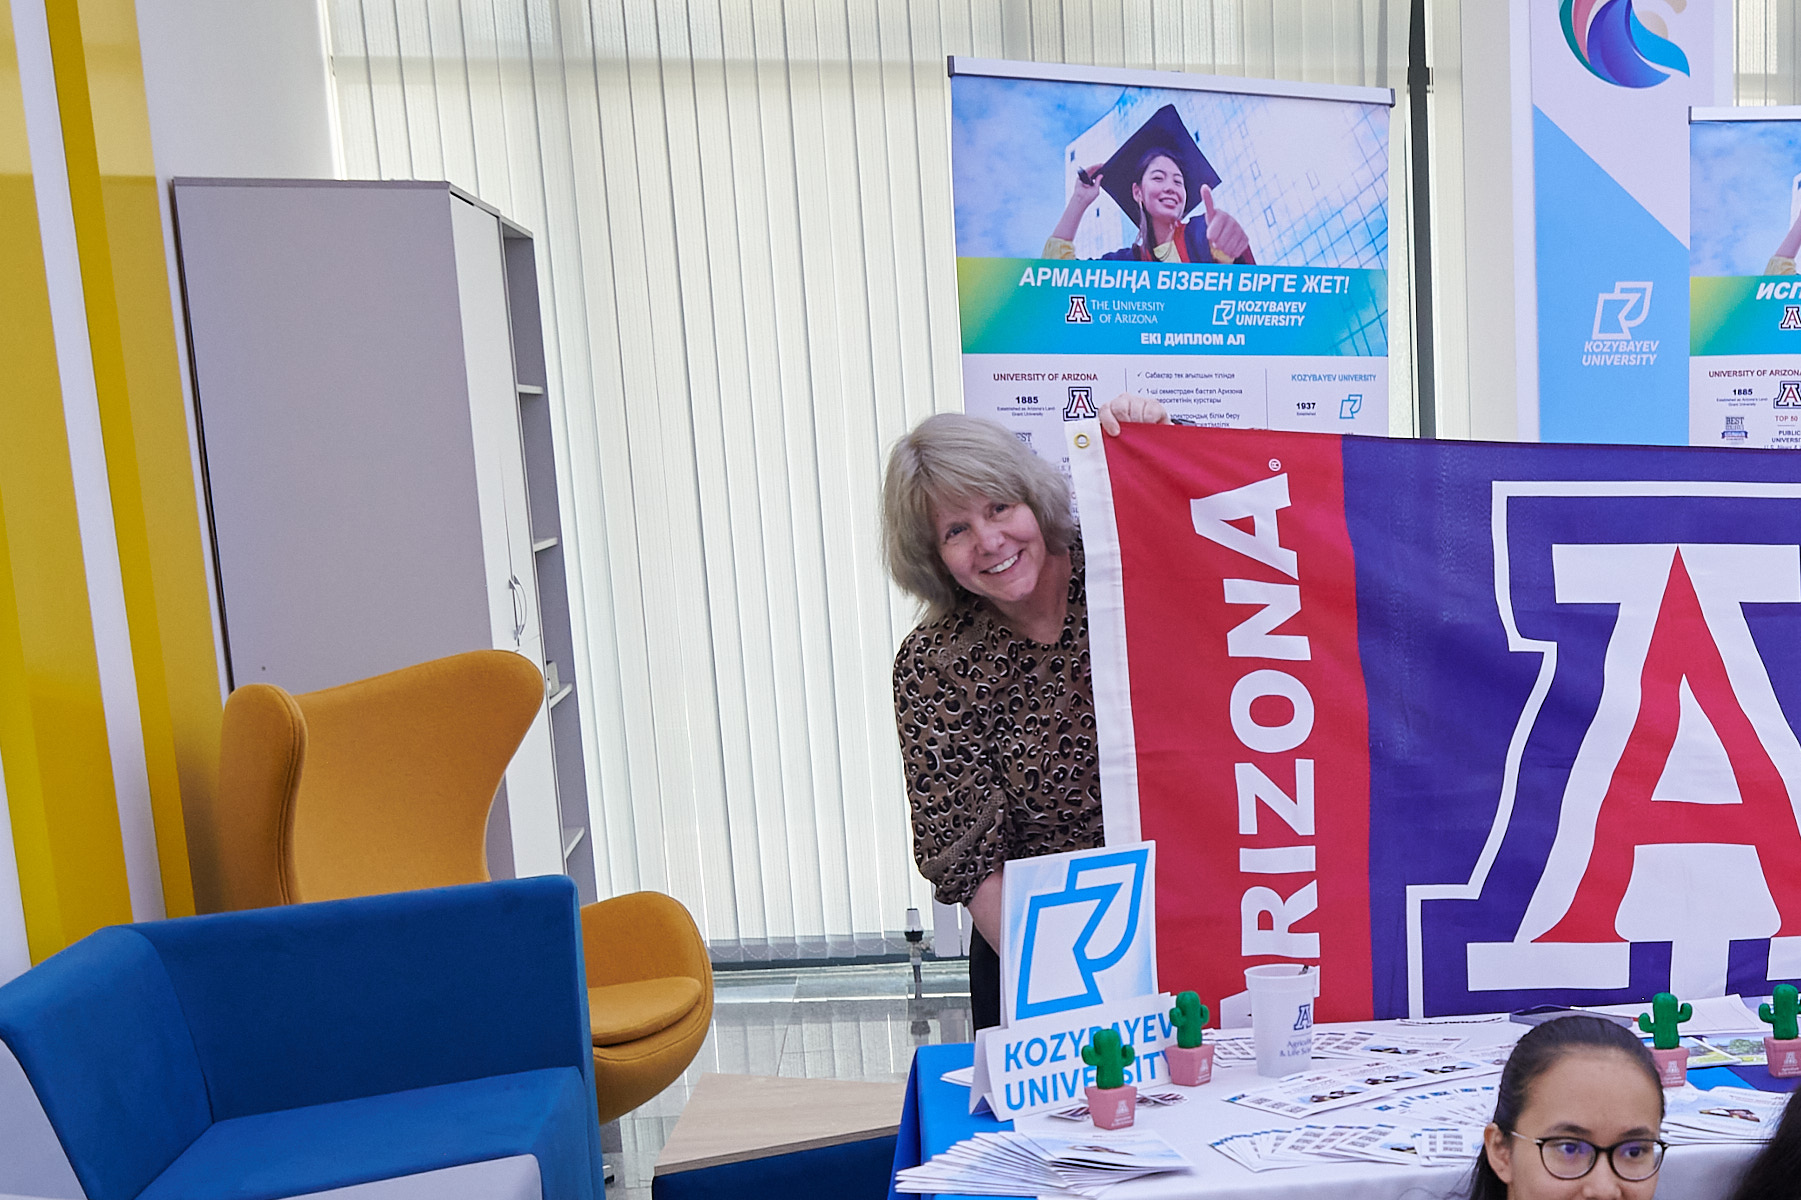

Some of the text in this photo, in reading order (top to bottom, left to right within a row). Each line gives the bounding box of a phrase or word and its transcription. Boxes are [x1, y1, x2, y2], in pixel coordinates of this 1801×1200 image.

[1019, 267, 1350, 295] АРМАНЫҢА БІЗБЕН БІРГЕ ЖЕТ!
[1091, 299, 1165, 313] THE UNIVERSITY
[1237, 300, 1307, 315] KOZYBAYEV
[1099, 312, 1158, 325] OF ARIZONA
[1235, 313, 1306, 327] UNIVERSITY
[1164, 333, 1224, 347] ДИПЛОМ
[1226, 334, 1246, 346] АЛ
[1584, 340, 1660, 353] KOZYBAYEV
[1581, 353, 1658, 366] UNIVERSITY
[993, 373, 1046, 381] UNIVERSITY
[1061, 373, 1098, 381] ARIZONA
[1291, 374, 1376, 382] KOZYBAYEV UNIVERSITY
[1709, 370, 1755, 378] UNIVERSITY
[1015, 396, 1039, 404] 1885
[1063, 386, 1099, 421] A
[1296, 402, 1316, 410] 1937
[1293, 1004, 1312, 1030] A
[1005, 1051, 1171, 1110] UNIVEIT
